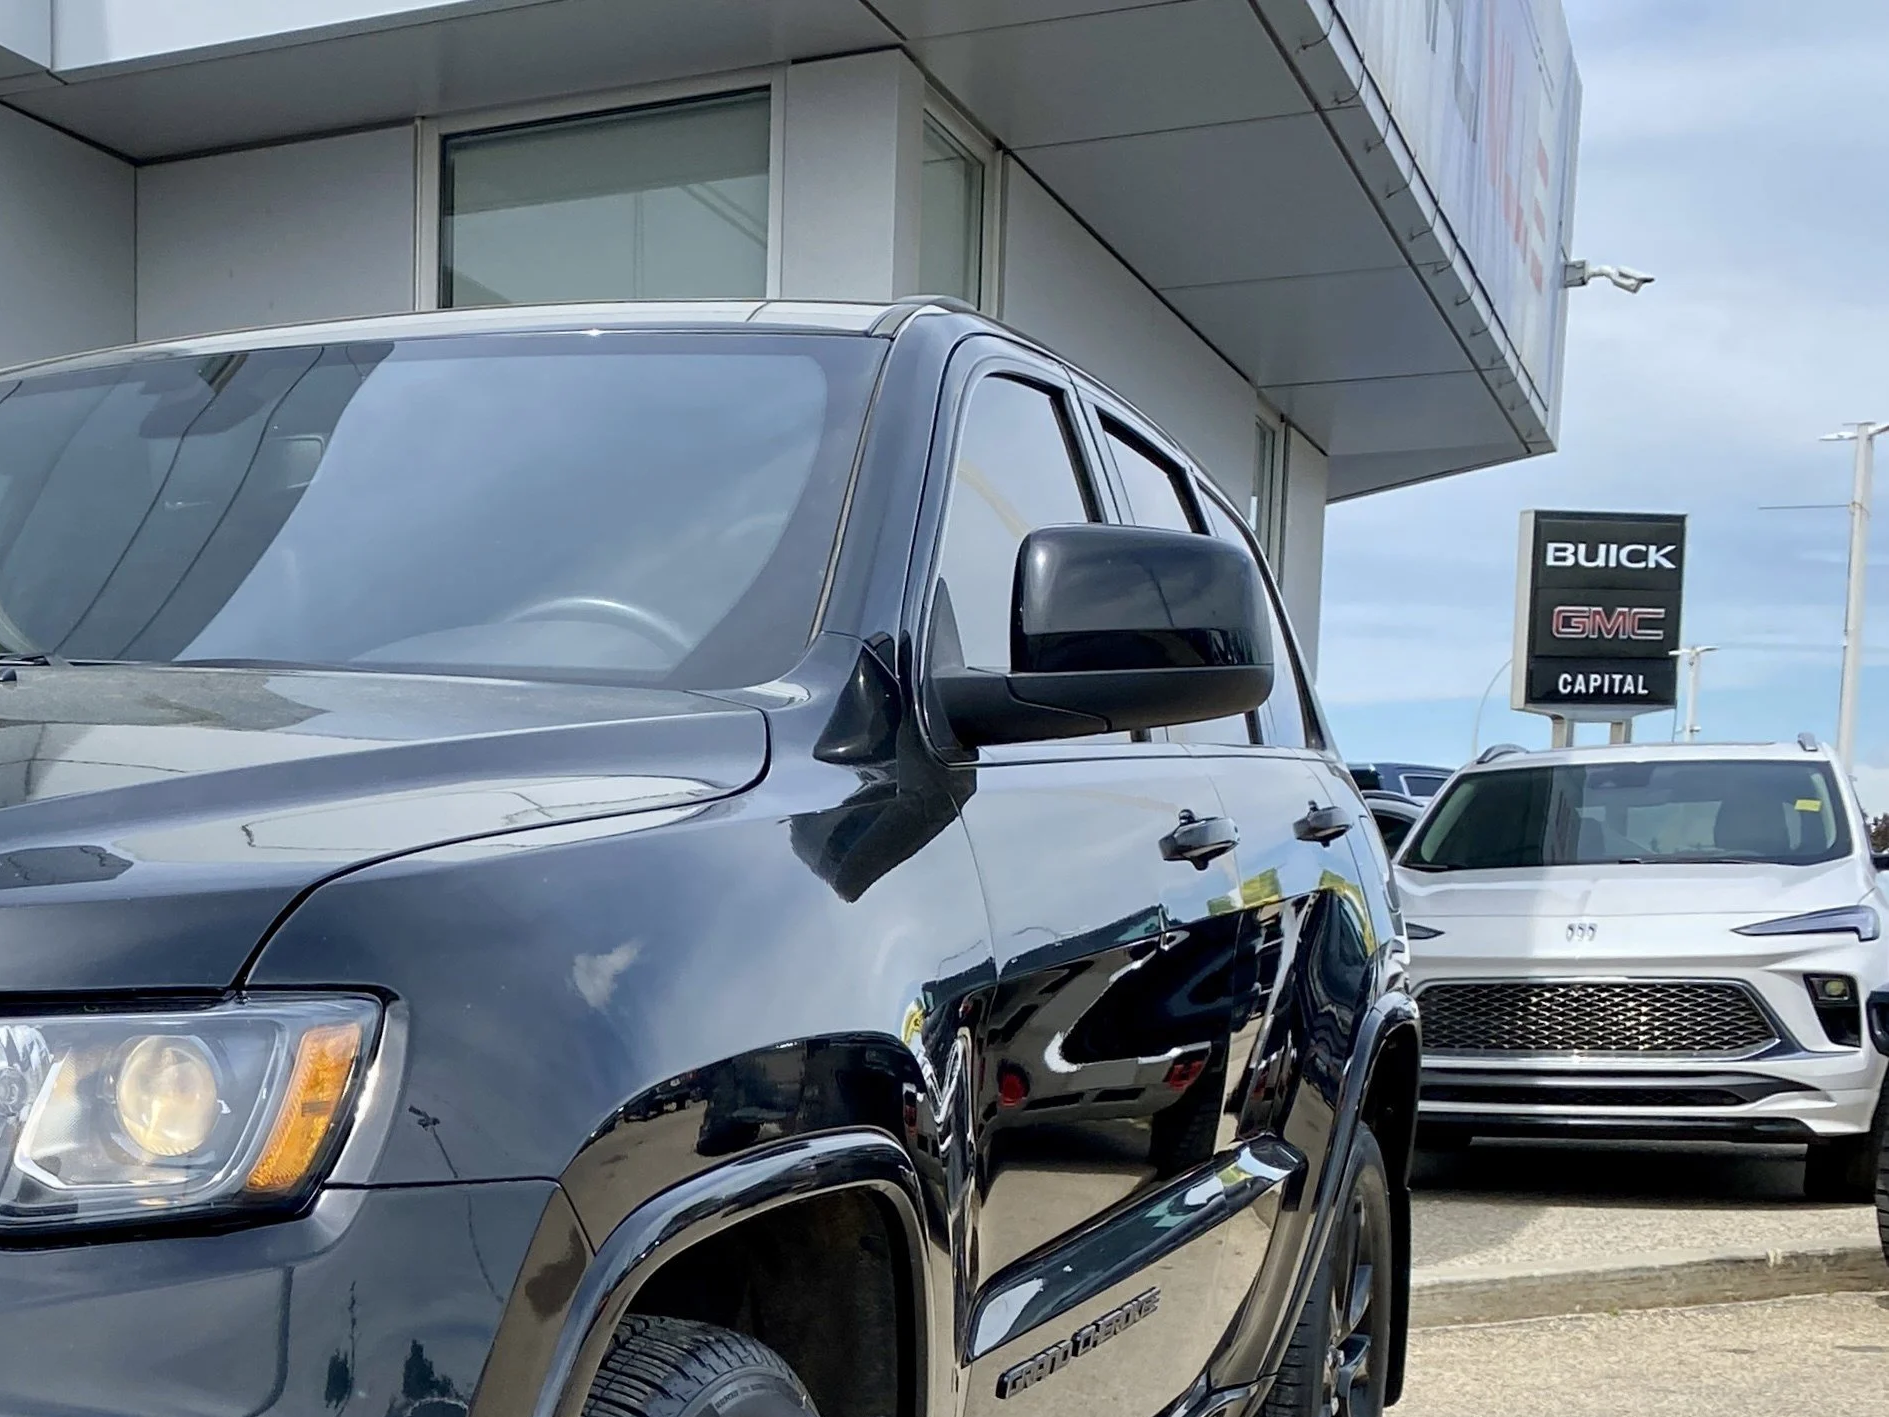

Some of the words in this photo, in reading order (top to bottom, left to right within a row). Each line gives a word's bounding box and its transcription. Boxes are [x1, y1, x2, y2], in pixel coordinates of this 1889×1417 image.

[1545, 542, 1677, 569] BUICK
[1552, 605, 1666, 640] GMC
[1558, 672, 1649, 695] CAPITAL
[995, 1339, 1074, 1400] GRAND
[1071, 1286, 1162, 1358] CHEROKEE
